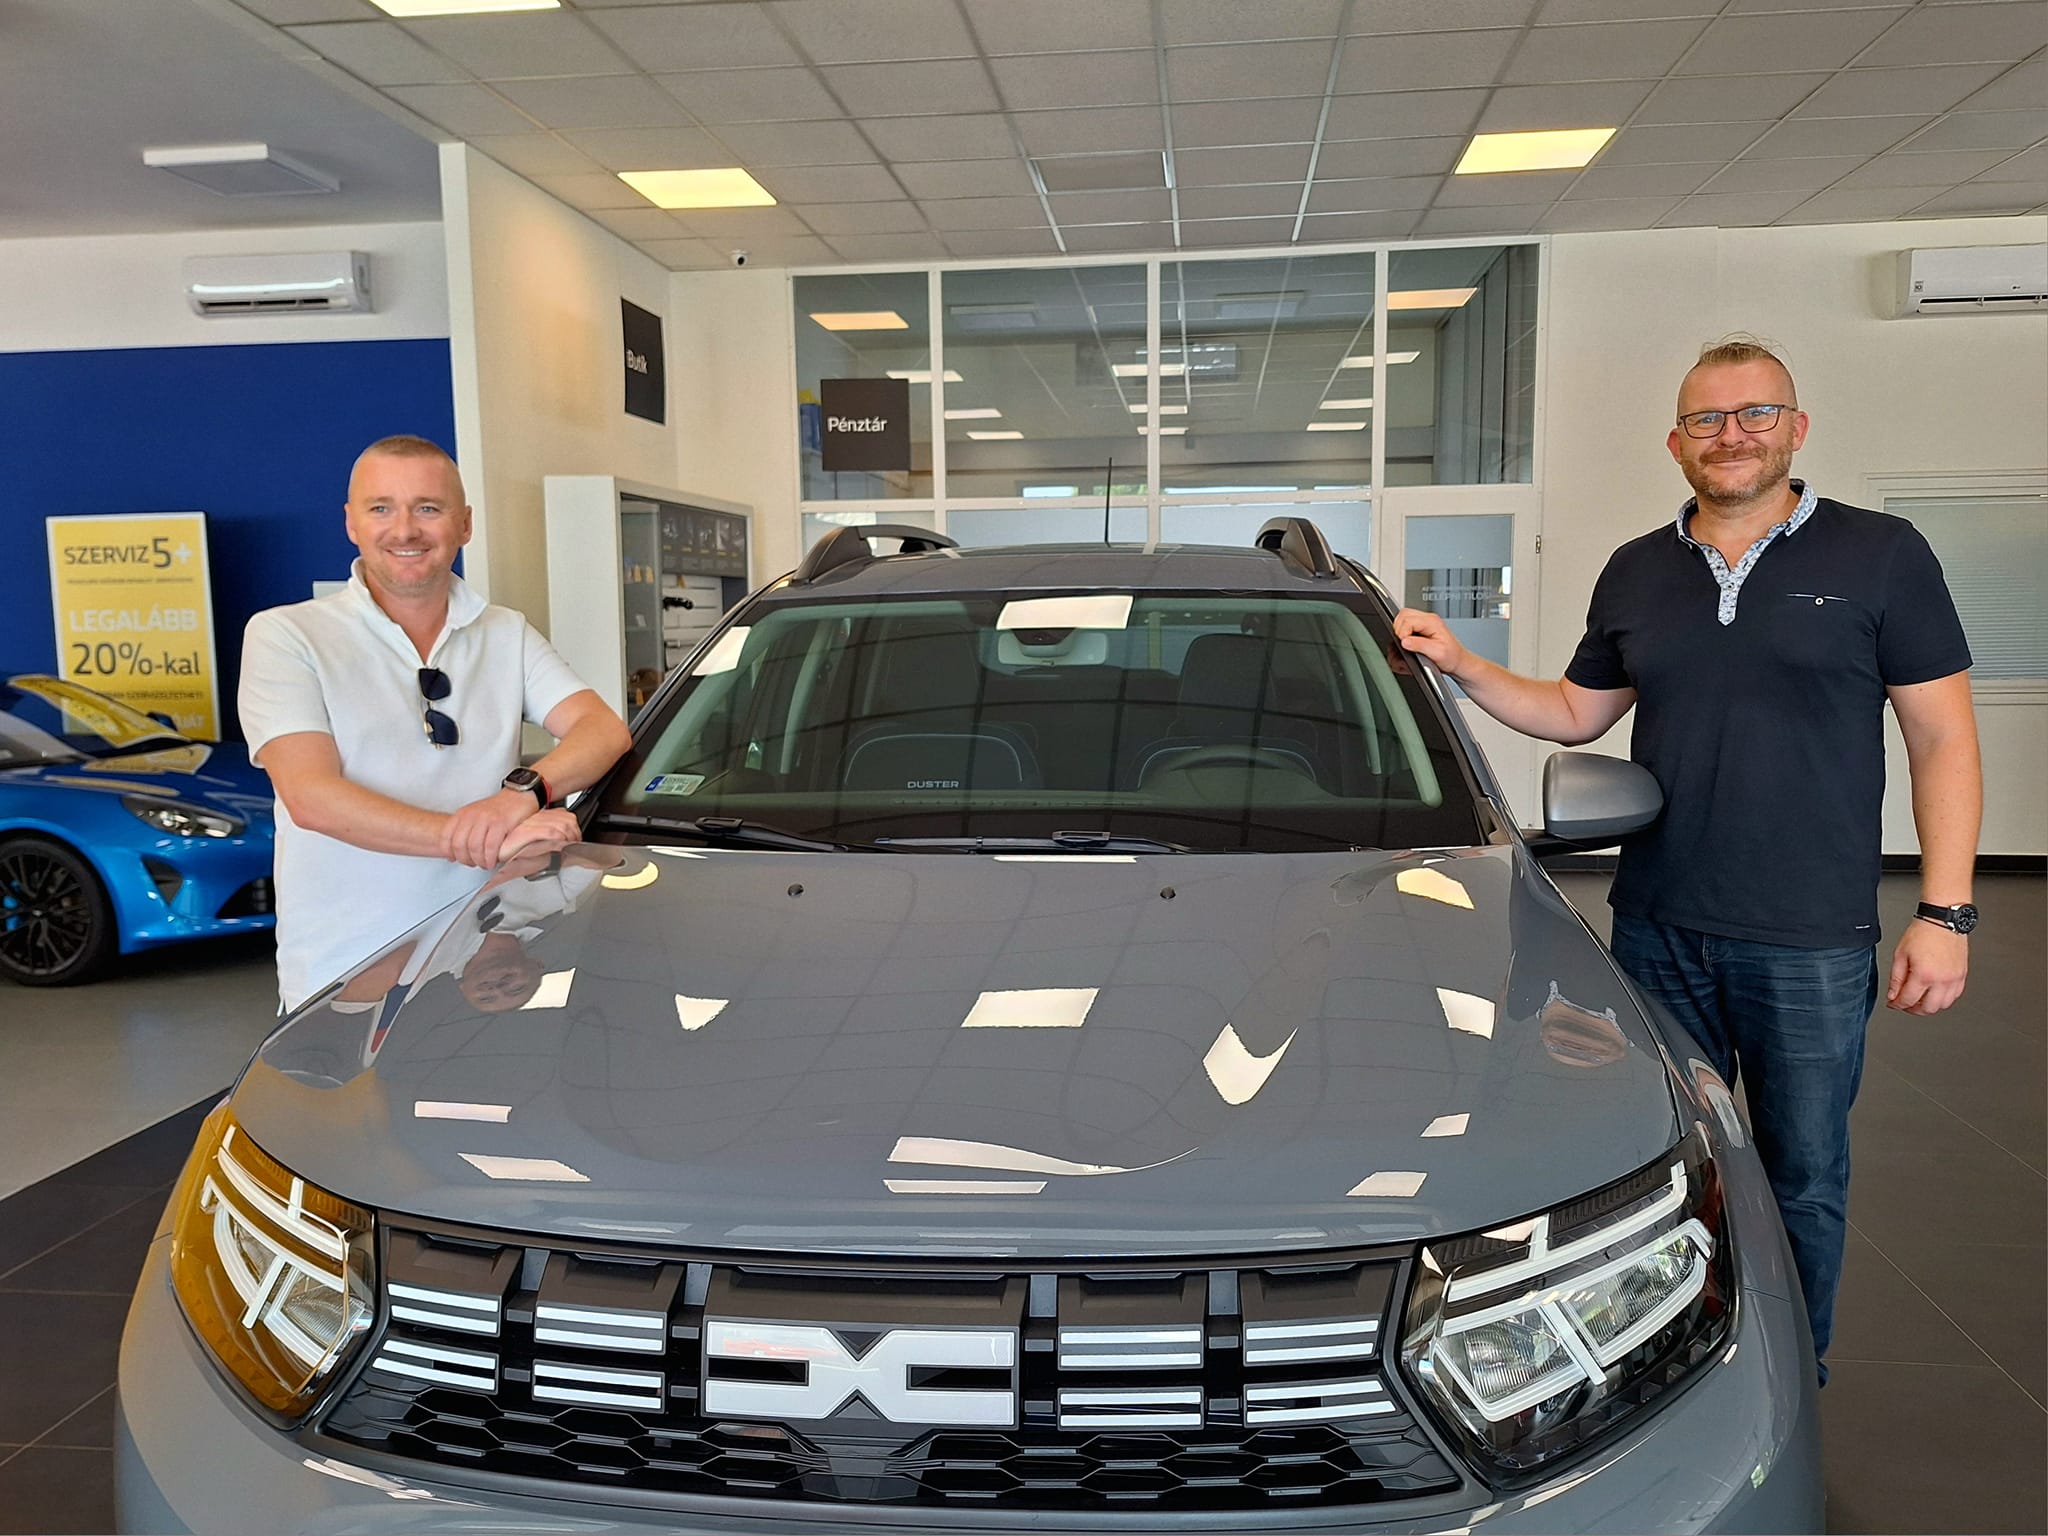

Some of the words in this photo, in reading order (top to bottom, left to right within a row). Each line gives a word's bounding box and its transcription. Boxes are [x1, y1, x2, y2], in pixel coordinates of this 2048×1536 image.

[626, 349, 648, 375] Butik
[828, 416, 888, 433] Pénztár
[64, 545, 149, 565] SZERVIZ
[69, 604, 199, 632] LEGALÁBB
[72, 642, 201, 675] 20%-kal
[907, 781, 960, 789] DUSTER
